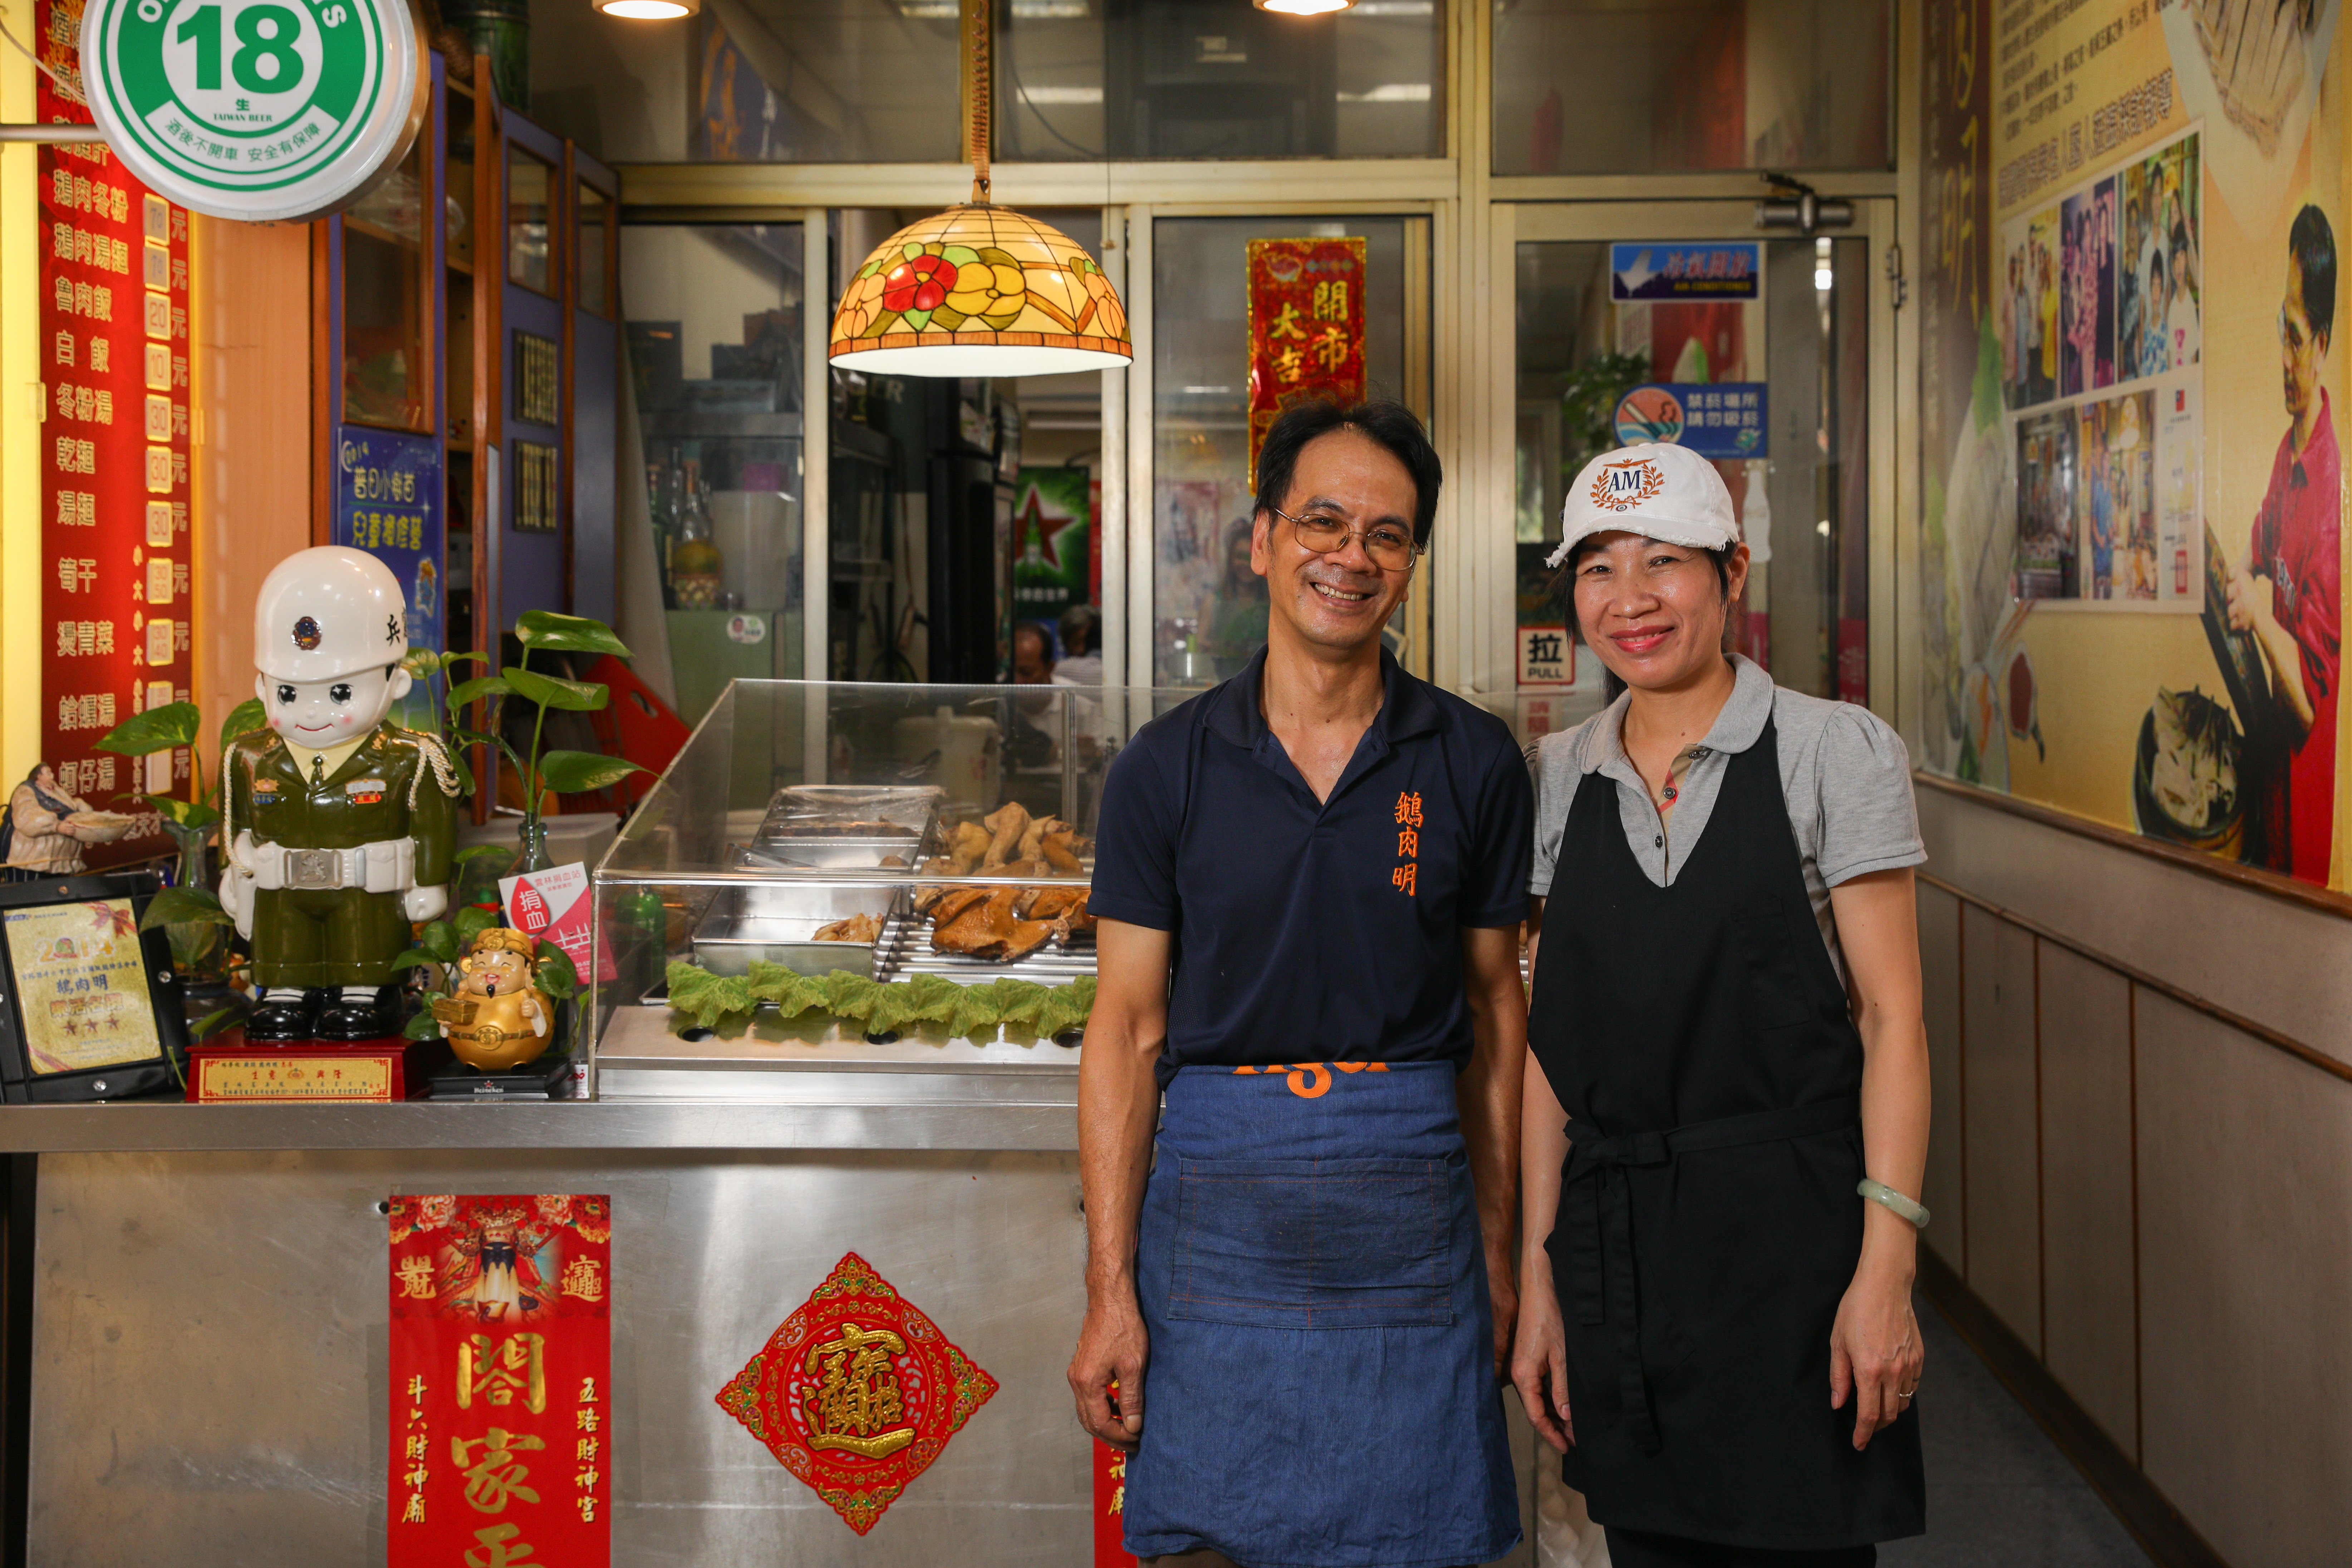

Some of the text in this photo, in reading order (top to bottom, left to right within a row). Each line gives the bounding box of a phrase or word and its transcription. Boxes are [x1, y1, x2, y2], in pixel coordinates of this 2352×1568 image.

[177, 4, 304, 94] 18
[213, 113, 272, 122] TAIWAN BEER
[235, 98, 250, 111] 生
[165, 118, 321, 162] 酒後不開車 安全有保障
[54, 169, 129, 223] 鵝肉冬粉
[171, 210, 187, 242] 元
[54, 222, 129, 275] 鵝肉湯麵
[172, 259, 187, 290] 元
[55, 275, 187, 339] 魯肉飯 20 元
[1311, 280, 1349, 374] 開市
[1270, 302, 1308, 384] 大吉
[172, 356, 188, 387] 元
[57, 382, 188, 436] 冬粉湯 30 元
[152, 456, 167, 481] 30
[172, 453, 187, 484] 元
[1608, 470, 1642, 492] AM
[152, 510, 167, 536] 30
[173, 501, 187, 532] 元
[57, 620, 115, 657] 燙青菜
[1528, 633, 1563, 664] 拉
[1528, 667, 1563, 679] PULL
[174, 749, 190, 780] 元
[1392, 791, 1424, 896] 鵝肉明
[535, 870, 581, 888] 雲林捐血站
[519, 890, 548, 930] 捐血
[402, 1375, 429, 1524] 斗六財神廟
[576, 1377, 600, 1523] 五路財神宮
